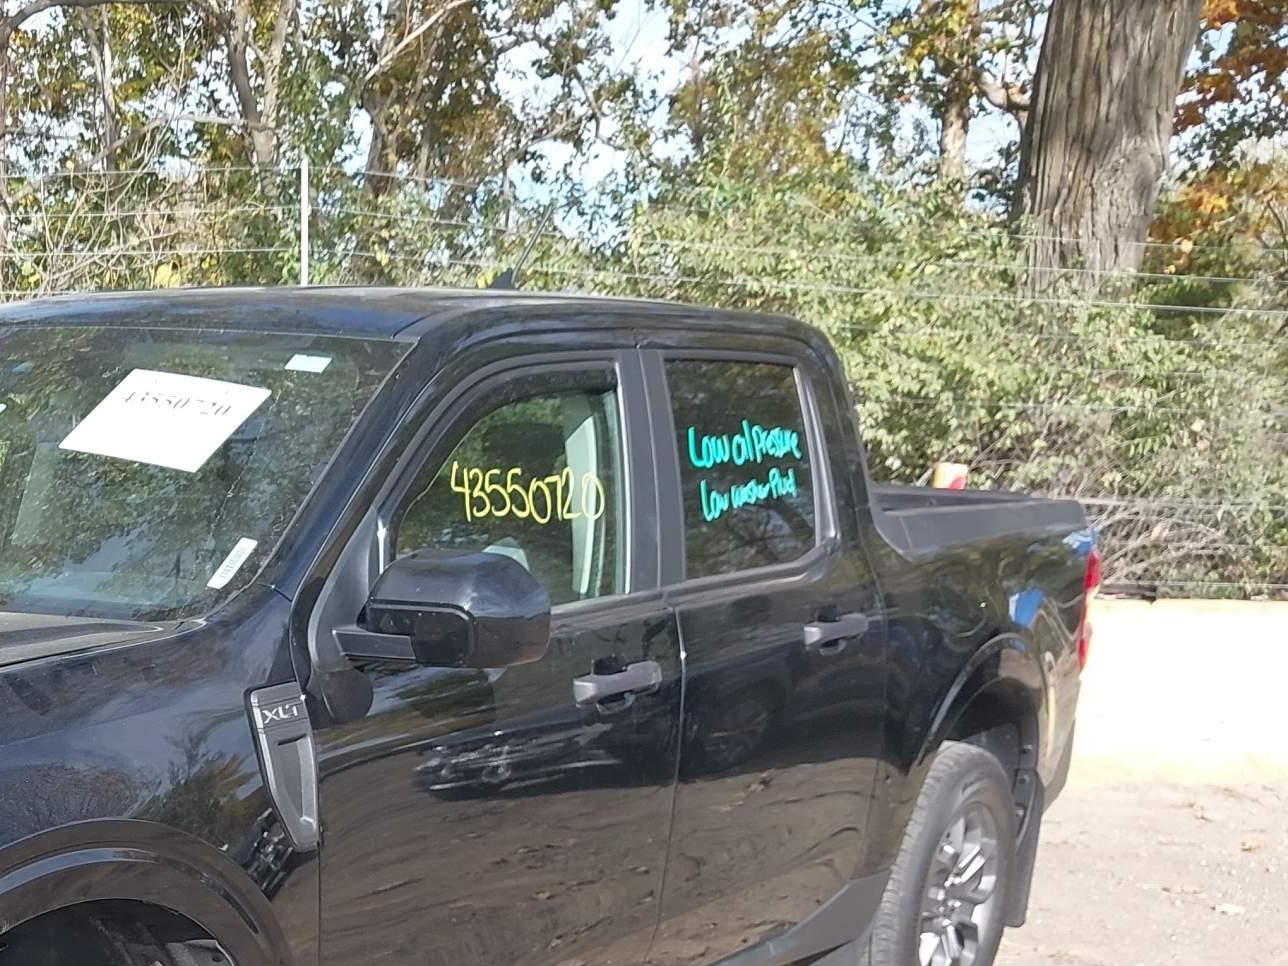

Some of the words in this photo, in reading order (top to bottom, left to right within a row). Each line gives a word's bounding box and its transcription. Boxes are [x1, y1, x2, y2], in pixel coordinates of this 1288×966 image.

[688, 426, 730, 468] Low
[451, 461, 605, 524] 43550720
[700, 479, 729, 522] Low
[262, 704, 299, 724] XLT
